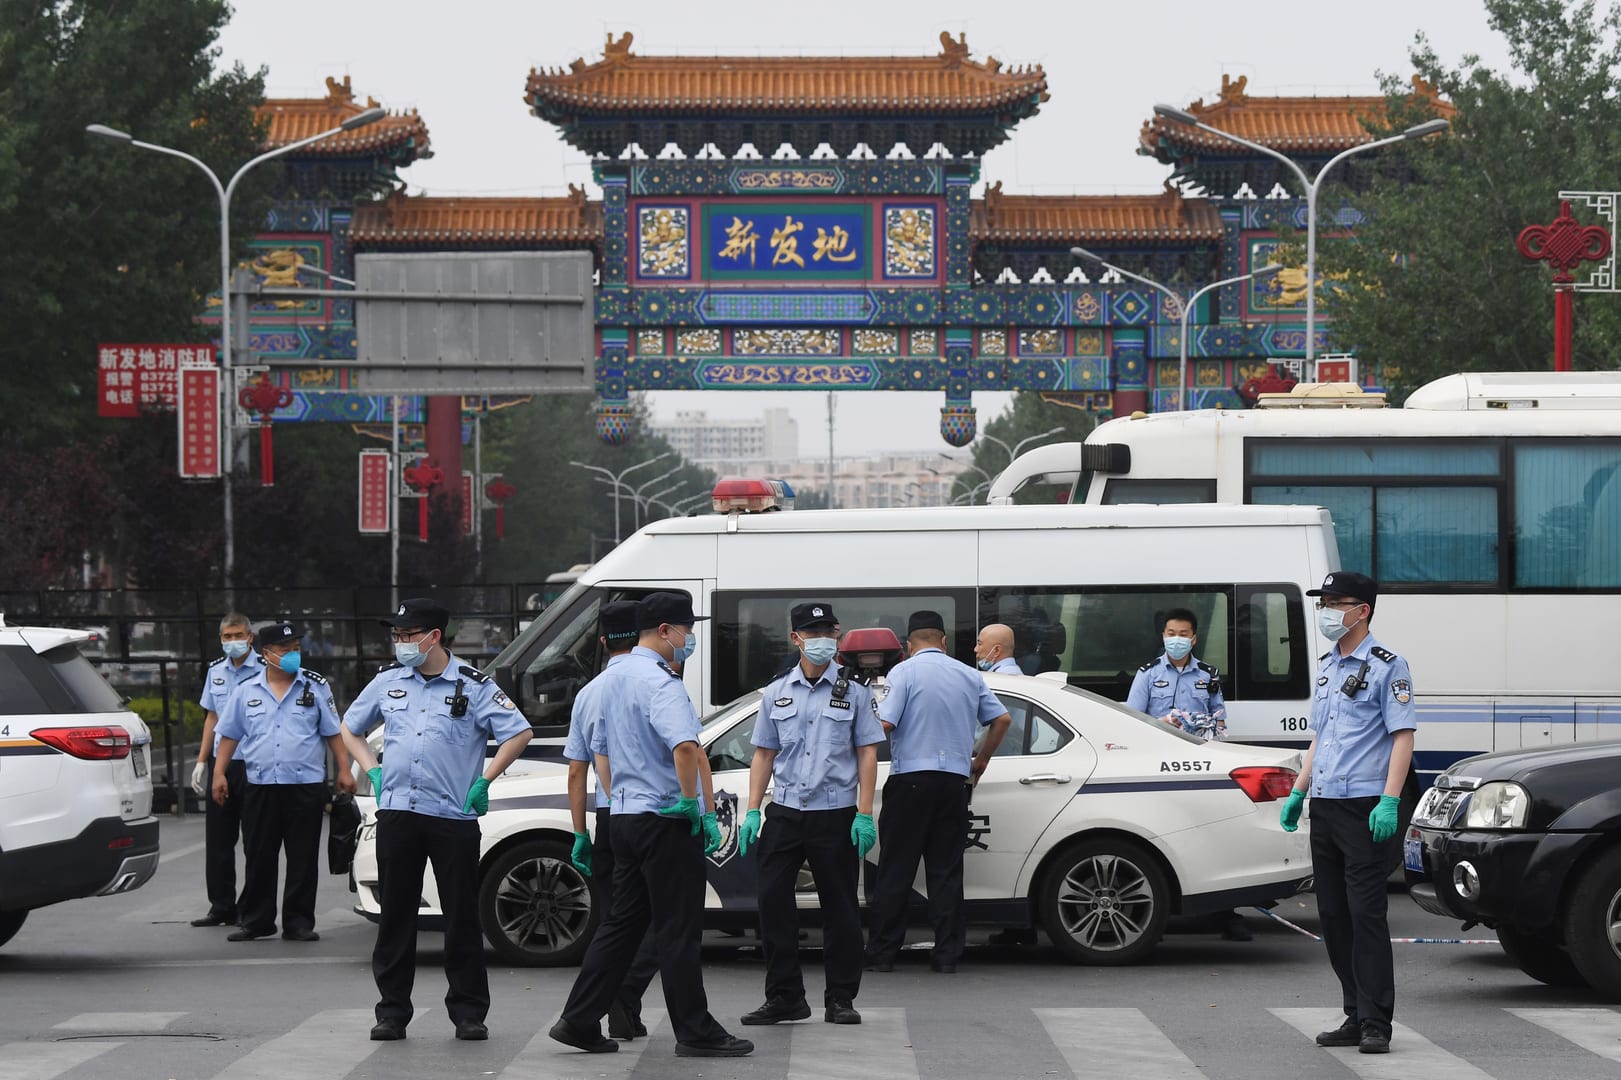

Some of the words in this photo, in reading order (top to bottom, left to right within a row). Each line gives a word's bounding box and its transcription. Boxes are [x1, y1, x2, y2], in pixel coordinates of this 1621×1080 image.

[718, 216, 856, 269] 新发地
[100, 348, 212, 369] 新发地消防队
[106, 371, 133, 387] 报警
[106, 390, 133, 405] 电话
[1, 724, 10, 737] 4
[1280, 717, 1309, 732] 180
[1160, 760, 1213, 773] A9557
